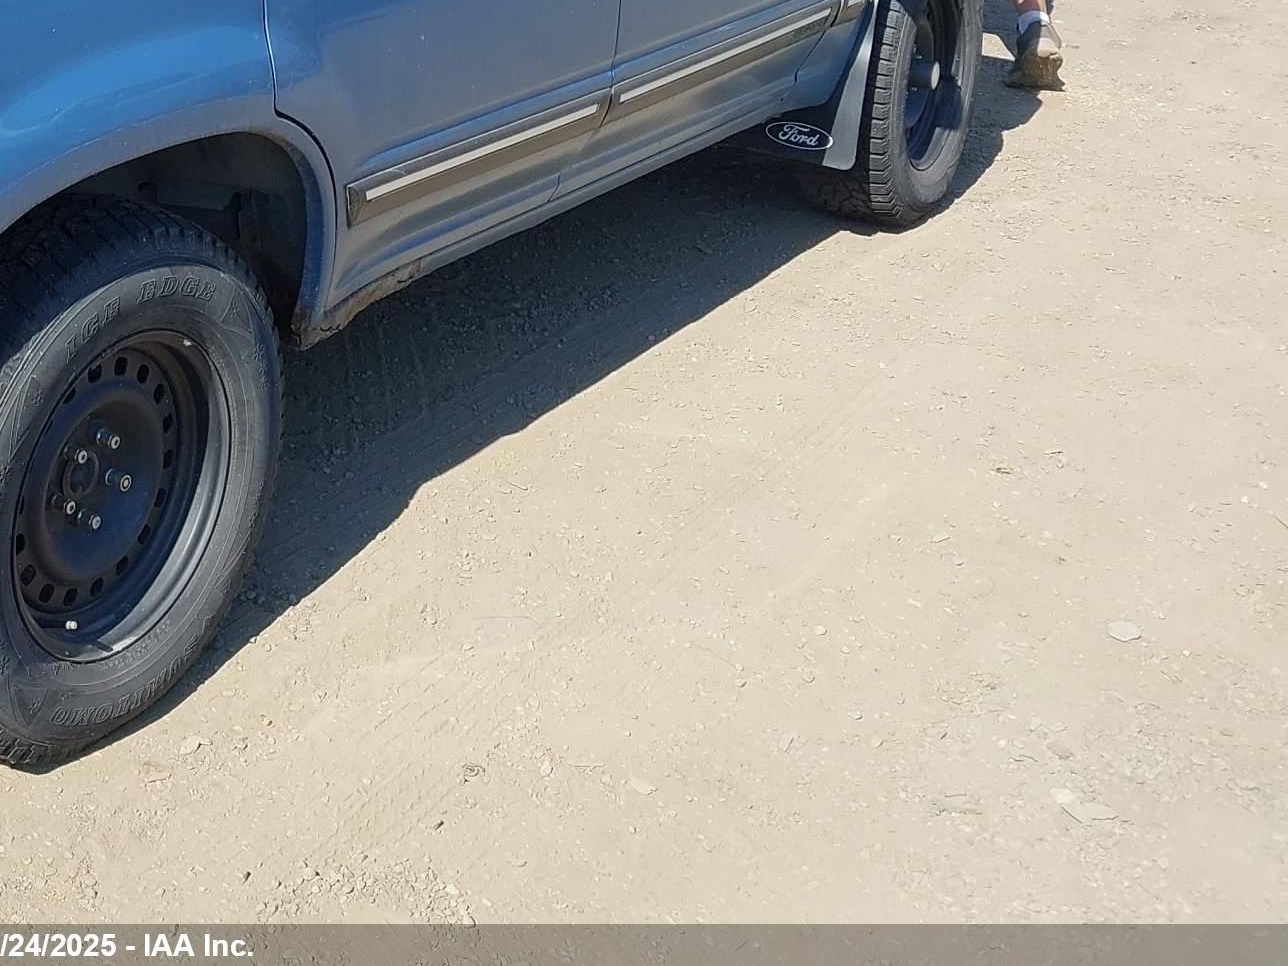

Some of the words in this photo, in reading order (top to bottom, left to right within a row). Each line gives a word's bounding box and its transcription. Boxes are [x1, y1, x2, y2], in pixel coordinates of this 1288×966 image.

[778, 124, 820, 146] Ford
[64, 295, 121, 363] ICE
[135, 274, 217, 306] EDGE
